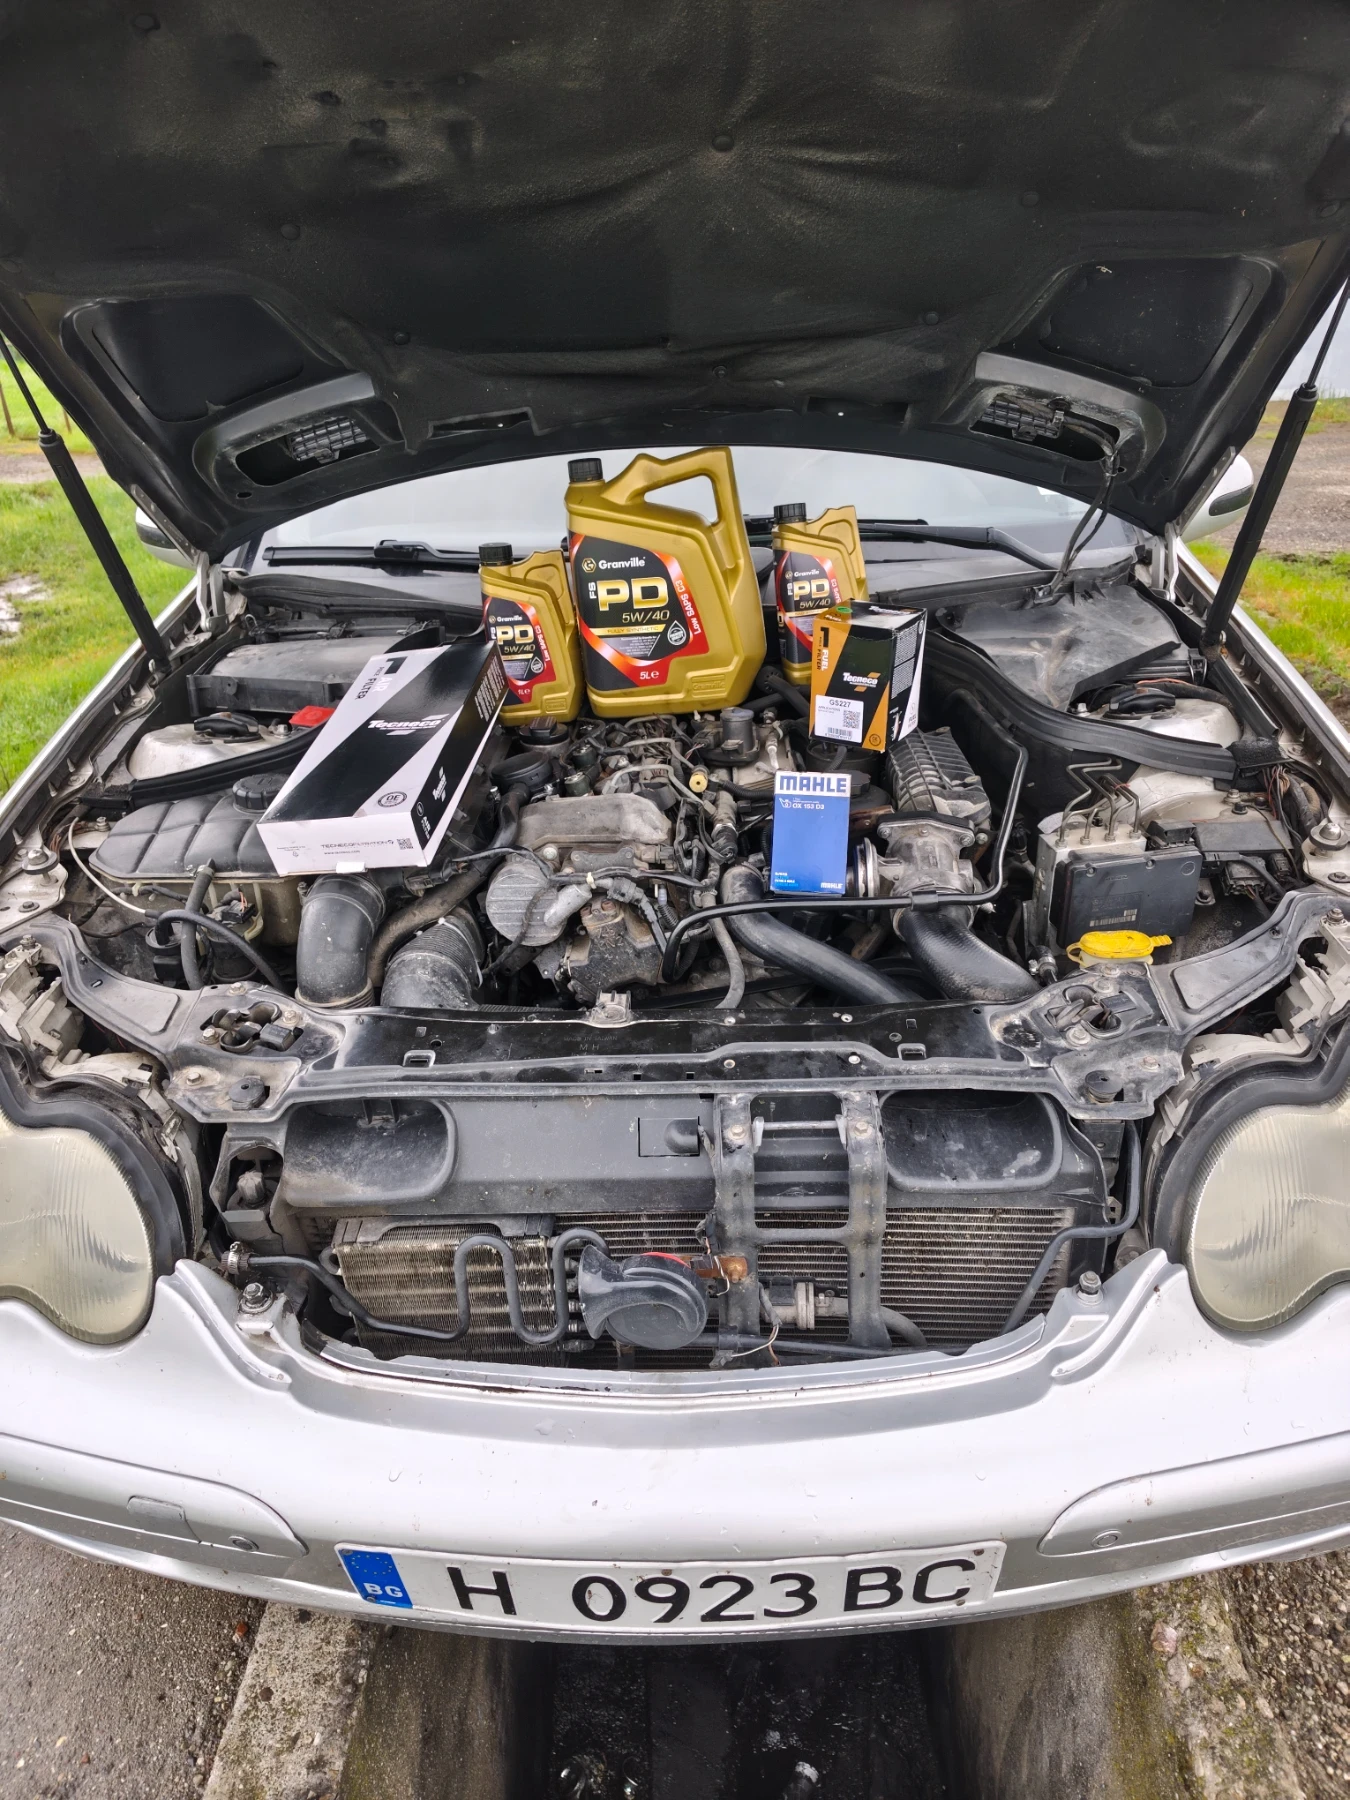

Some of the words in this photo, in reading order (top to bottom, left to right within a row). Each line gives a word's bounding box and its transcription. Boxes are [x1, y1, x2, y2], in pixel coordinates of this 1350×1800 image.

[598, 557, 646, 569] Granville
[793, 569, 820, 577] Granville
[588, 582, 597, 599] FS
[597, 577, 669, 611] PD
[675, 580, 685, 593] C3
[793, 578, 830, 600] PD
[680, 593, 695, 617] SAPS
[800, 599, 831, 609] 5W/40
[622, 610, 670, 623] 5W/40
[496, 624, 535, 645] PD
[504, 644, 536, 653] 5W/40
[821, 649, 829, 671] FUEL
[372, 677, 392, 692] AIR
[843, 672, 878, 685] Tecneco
[355, 678, 379, 700] FILTER
[829, 699, 851, 708] GS227
[367, 719, 443, 729] Tecneco
[779, 775, 847, 793] MAHLE
[362, 1582, 404, 1598] BG
[447, 1566, 517, 1615] H
[571, 1572, 818, 1623] 0923
[843, 1558, 976, 1612] BC
